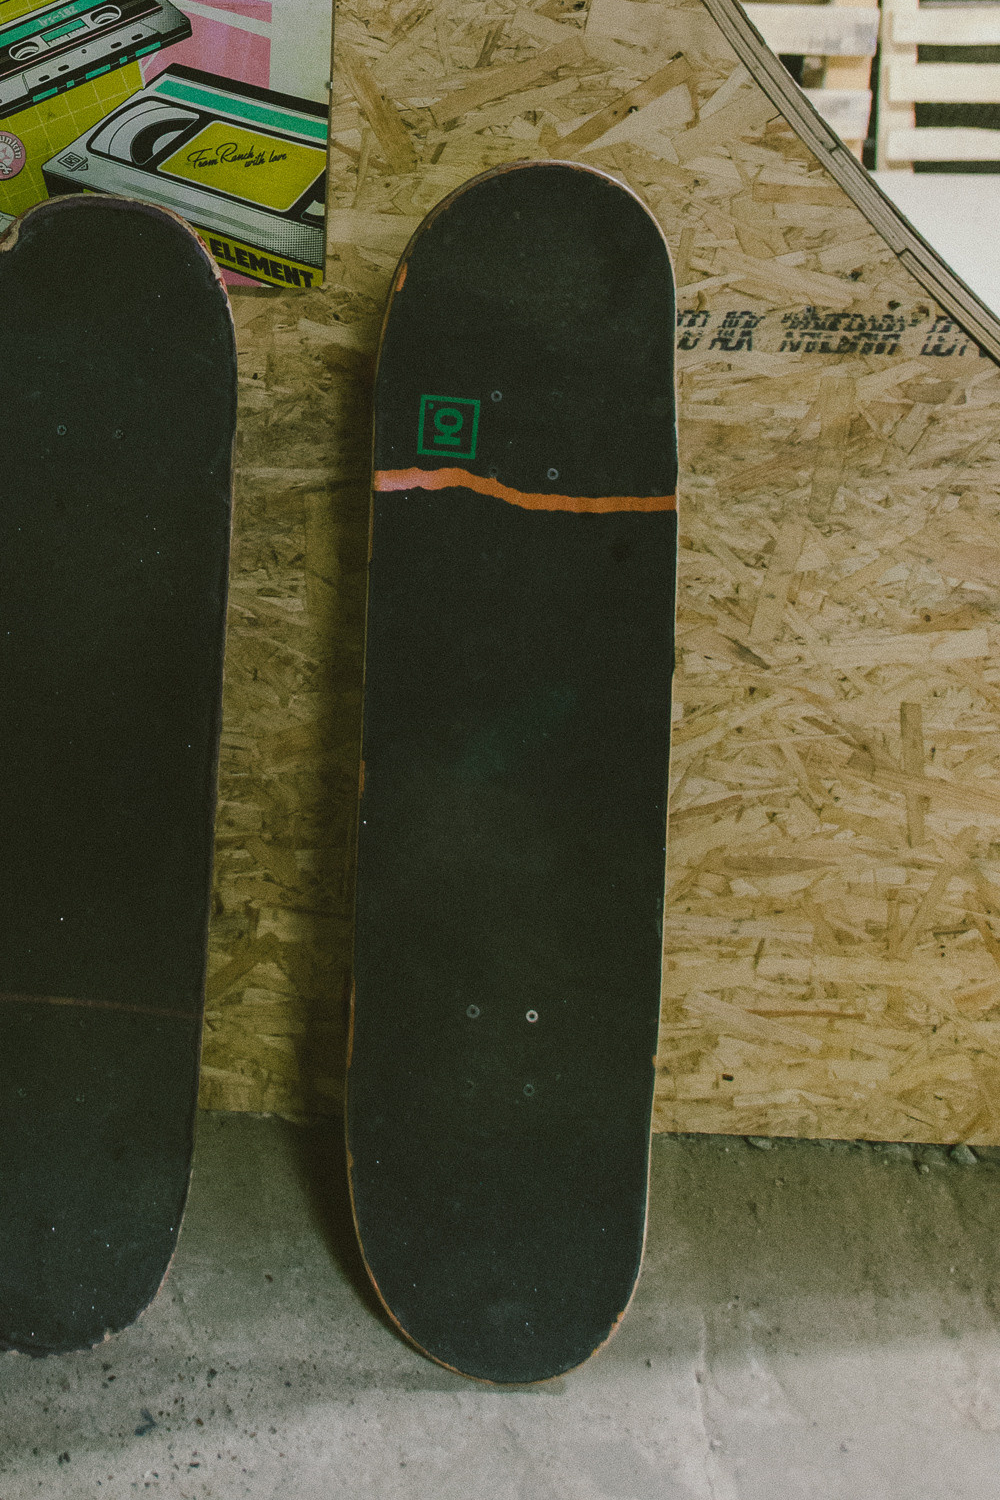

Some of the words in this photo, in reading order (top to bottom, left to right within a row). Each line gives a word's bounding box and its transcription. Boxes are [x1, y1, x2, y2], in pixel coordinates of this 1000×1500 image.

[187, 148, 218, 169] From
[216, 142, 255, 164] Ranch
[244, 151, 266, 168] with
[268, 149, 288, 163] love
[209, 238, 314, 288] ELEMENT
